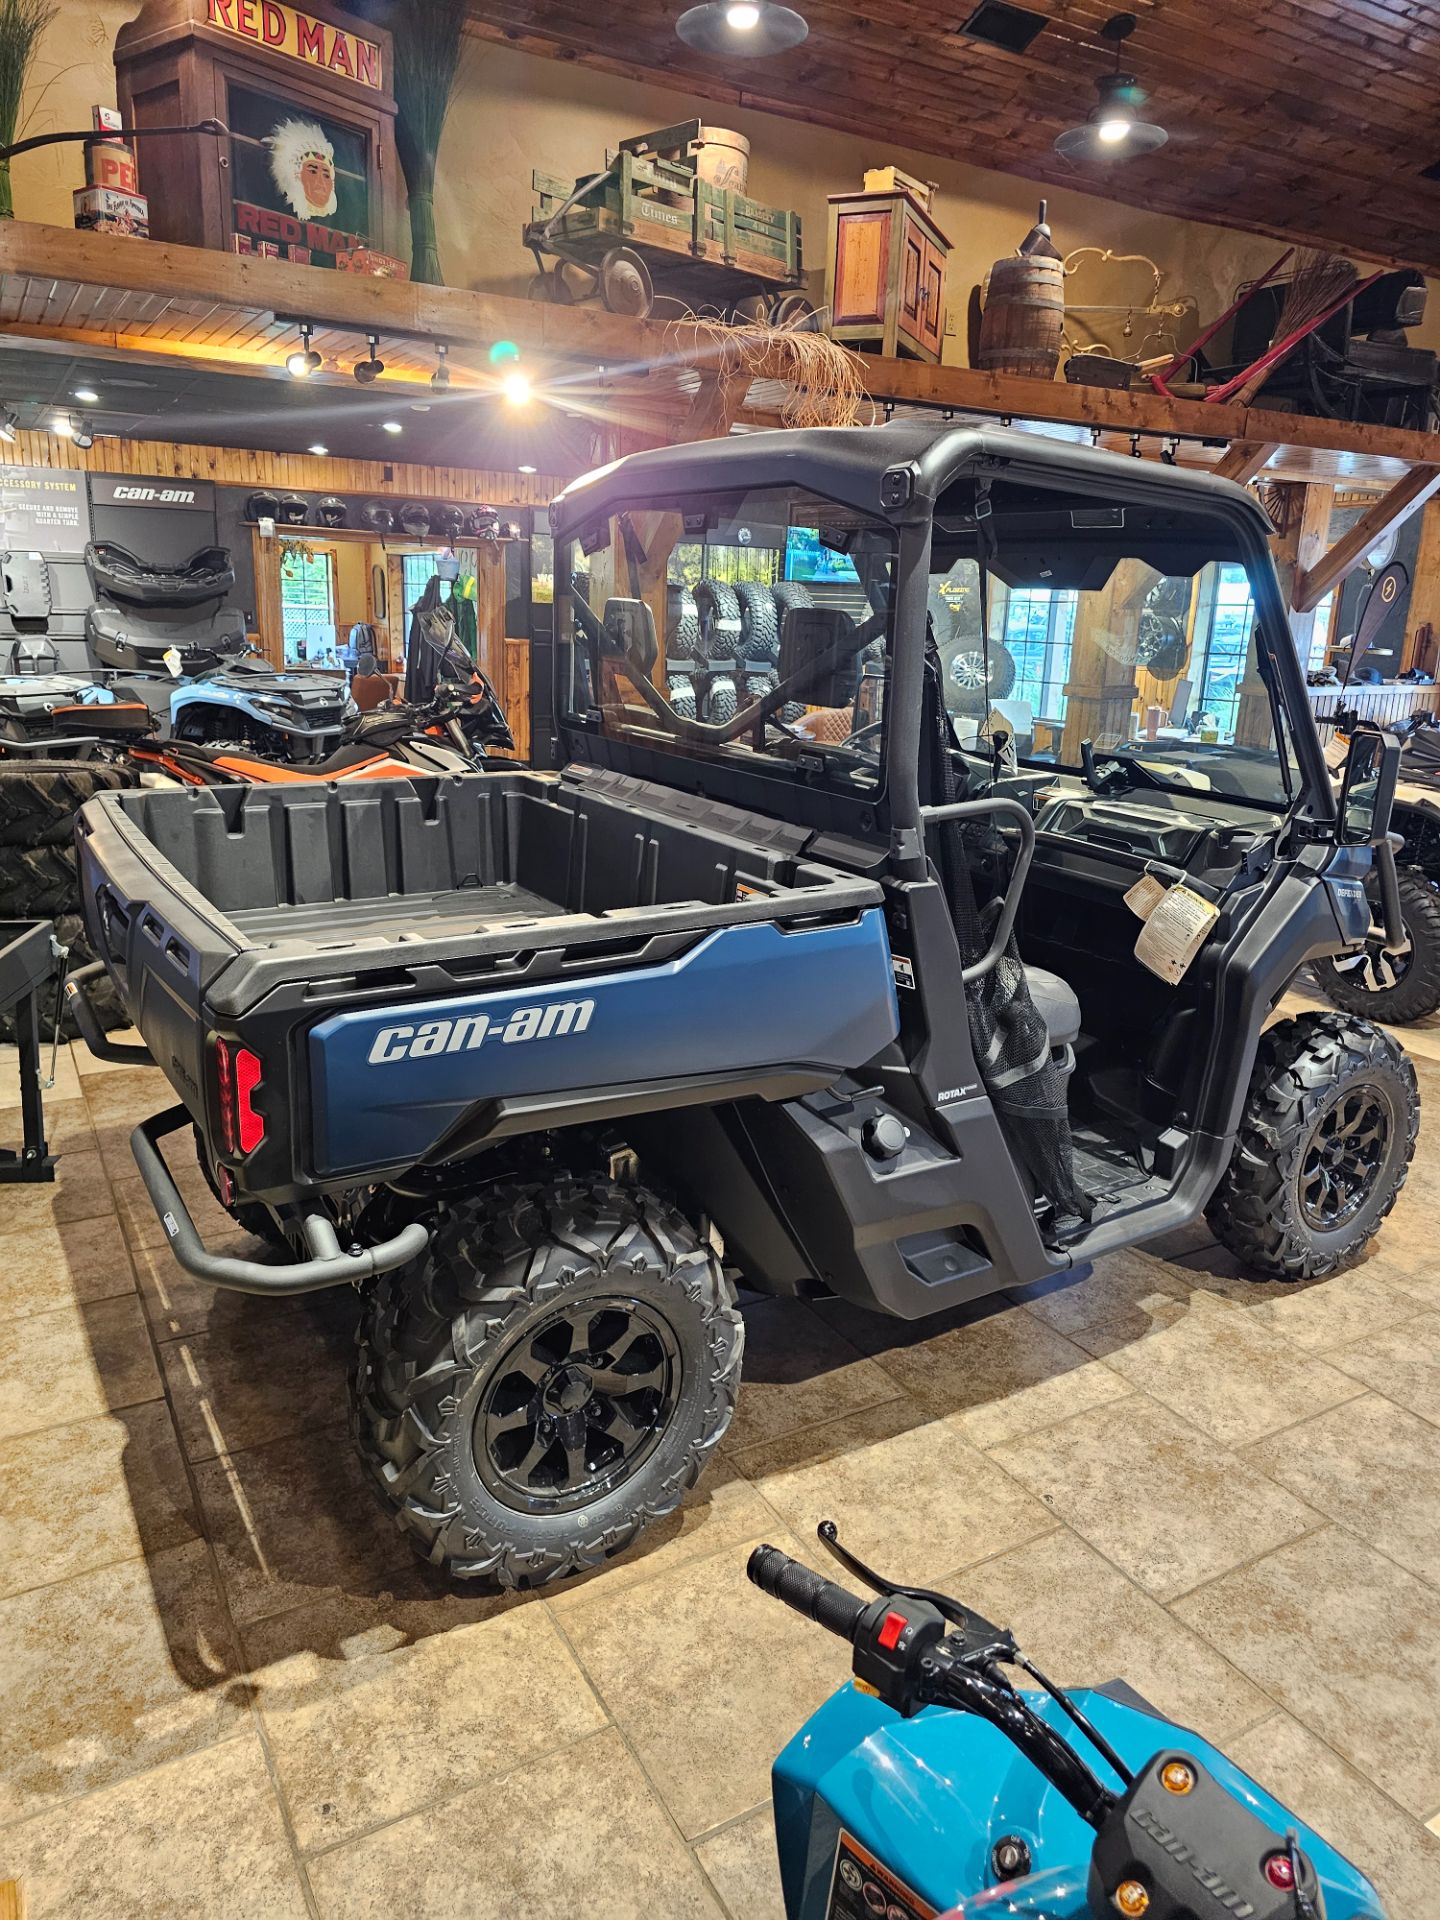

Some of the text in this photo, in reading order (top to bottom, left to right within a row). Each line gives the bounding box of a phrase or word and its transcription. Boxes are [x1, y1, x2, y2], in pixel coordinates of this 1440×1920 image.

[207, 0, 379, 88] RED MAN
[236, 202, 302, 244] RED
[641, 202, 679, 225] Times
[44, 481, 77, 492] SYSTEM
[367, 999, 596, 1065] can-am
[937, 1086, 967, 1102] ROTAX
[1128, 1808, 1254, 1918] can-am
